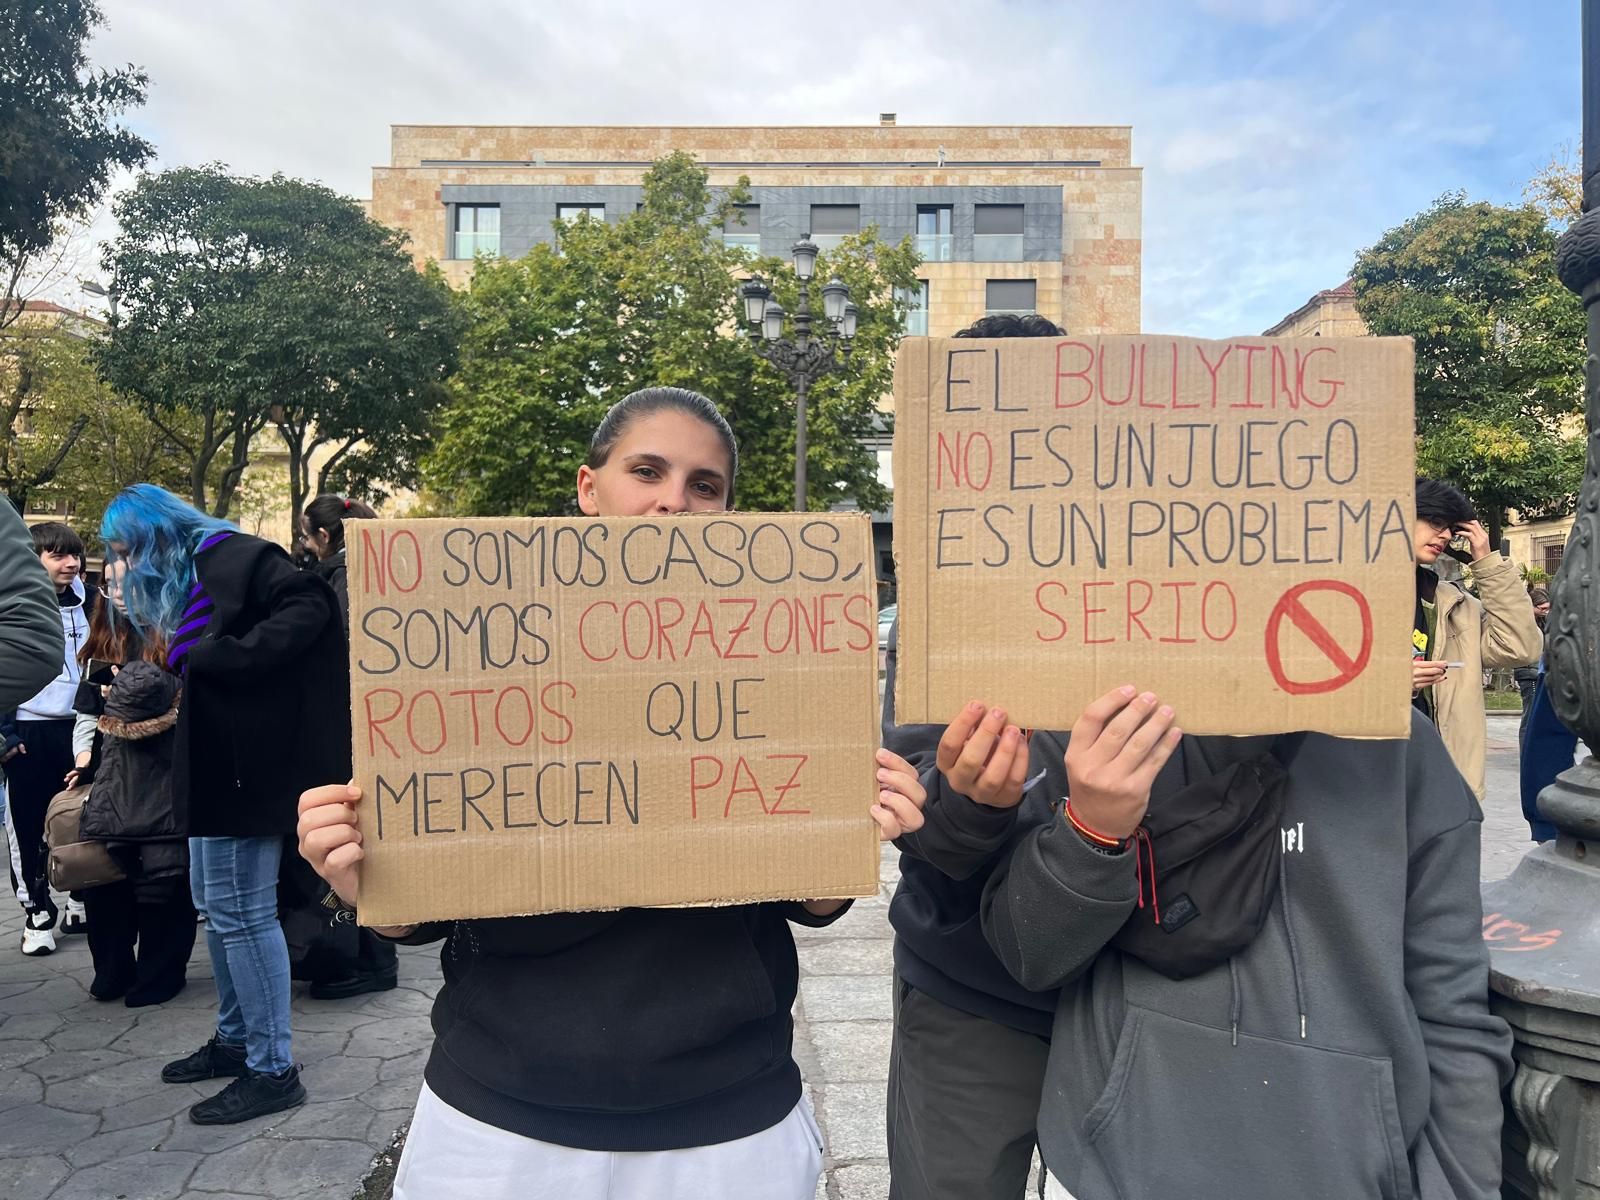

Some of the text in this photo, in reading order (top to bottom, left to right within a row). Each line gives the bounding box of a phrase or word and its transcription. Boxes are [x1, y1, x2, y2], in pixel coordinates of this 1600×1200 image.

[946, 342, 1344, 412] EL BULLYING
[936, 419, 1359, 491] NO ES UN JUEGO
[363, 520, 863, 595] NO SOMOS CASOS,
[937, 500, 1414, 569] ES UN PROBLEMA
[358, 594, 873, 674] SOMOS CORAZONES
[1036, 580, 1237, 644] SERIO
[364, 679, 766, 758] ROTOS QUE
[376, 755, 811, 840] MERECEN PAZ
